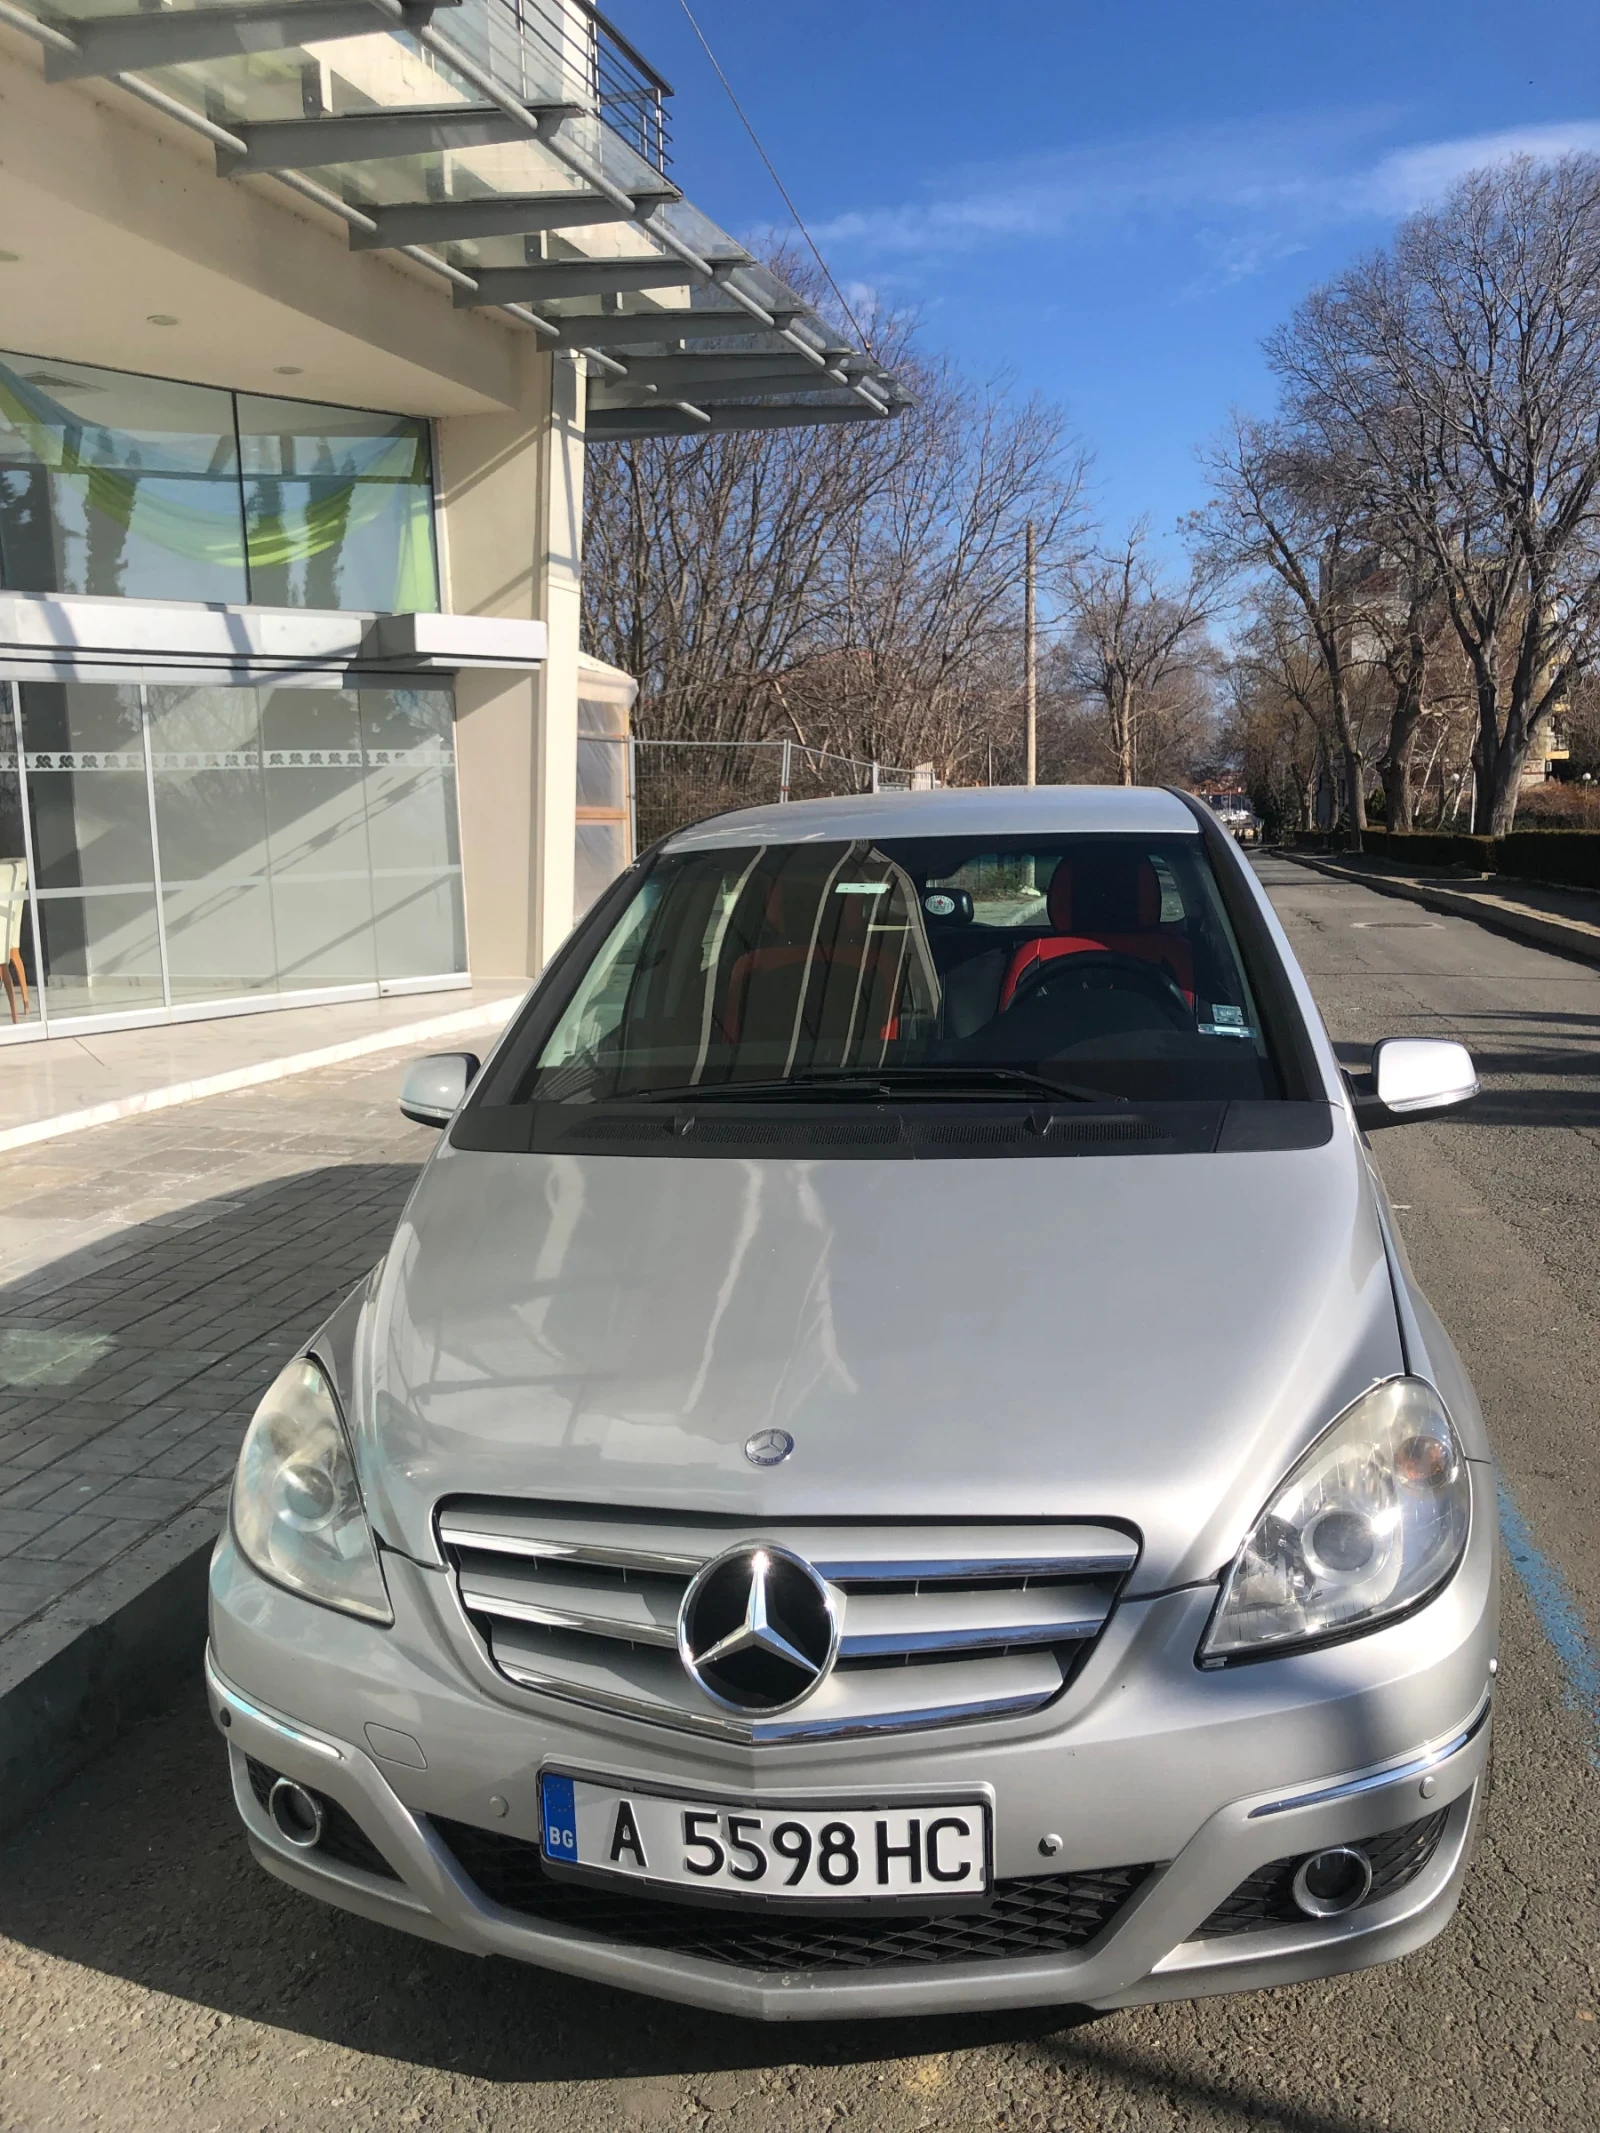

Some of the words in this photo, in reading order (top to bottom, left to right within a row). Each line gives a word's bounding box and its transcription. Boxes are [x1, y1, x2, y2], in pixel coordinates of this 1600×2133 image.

[549, 1826, 574, 1848] BG
[610, 1799, 648, 1868] A
[684, 1811, 859, 1886] 5598
[876, 1817, 971, 1885] HC
